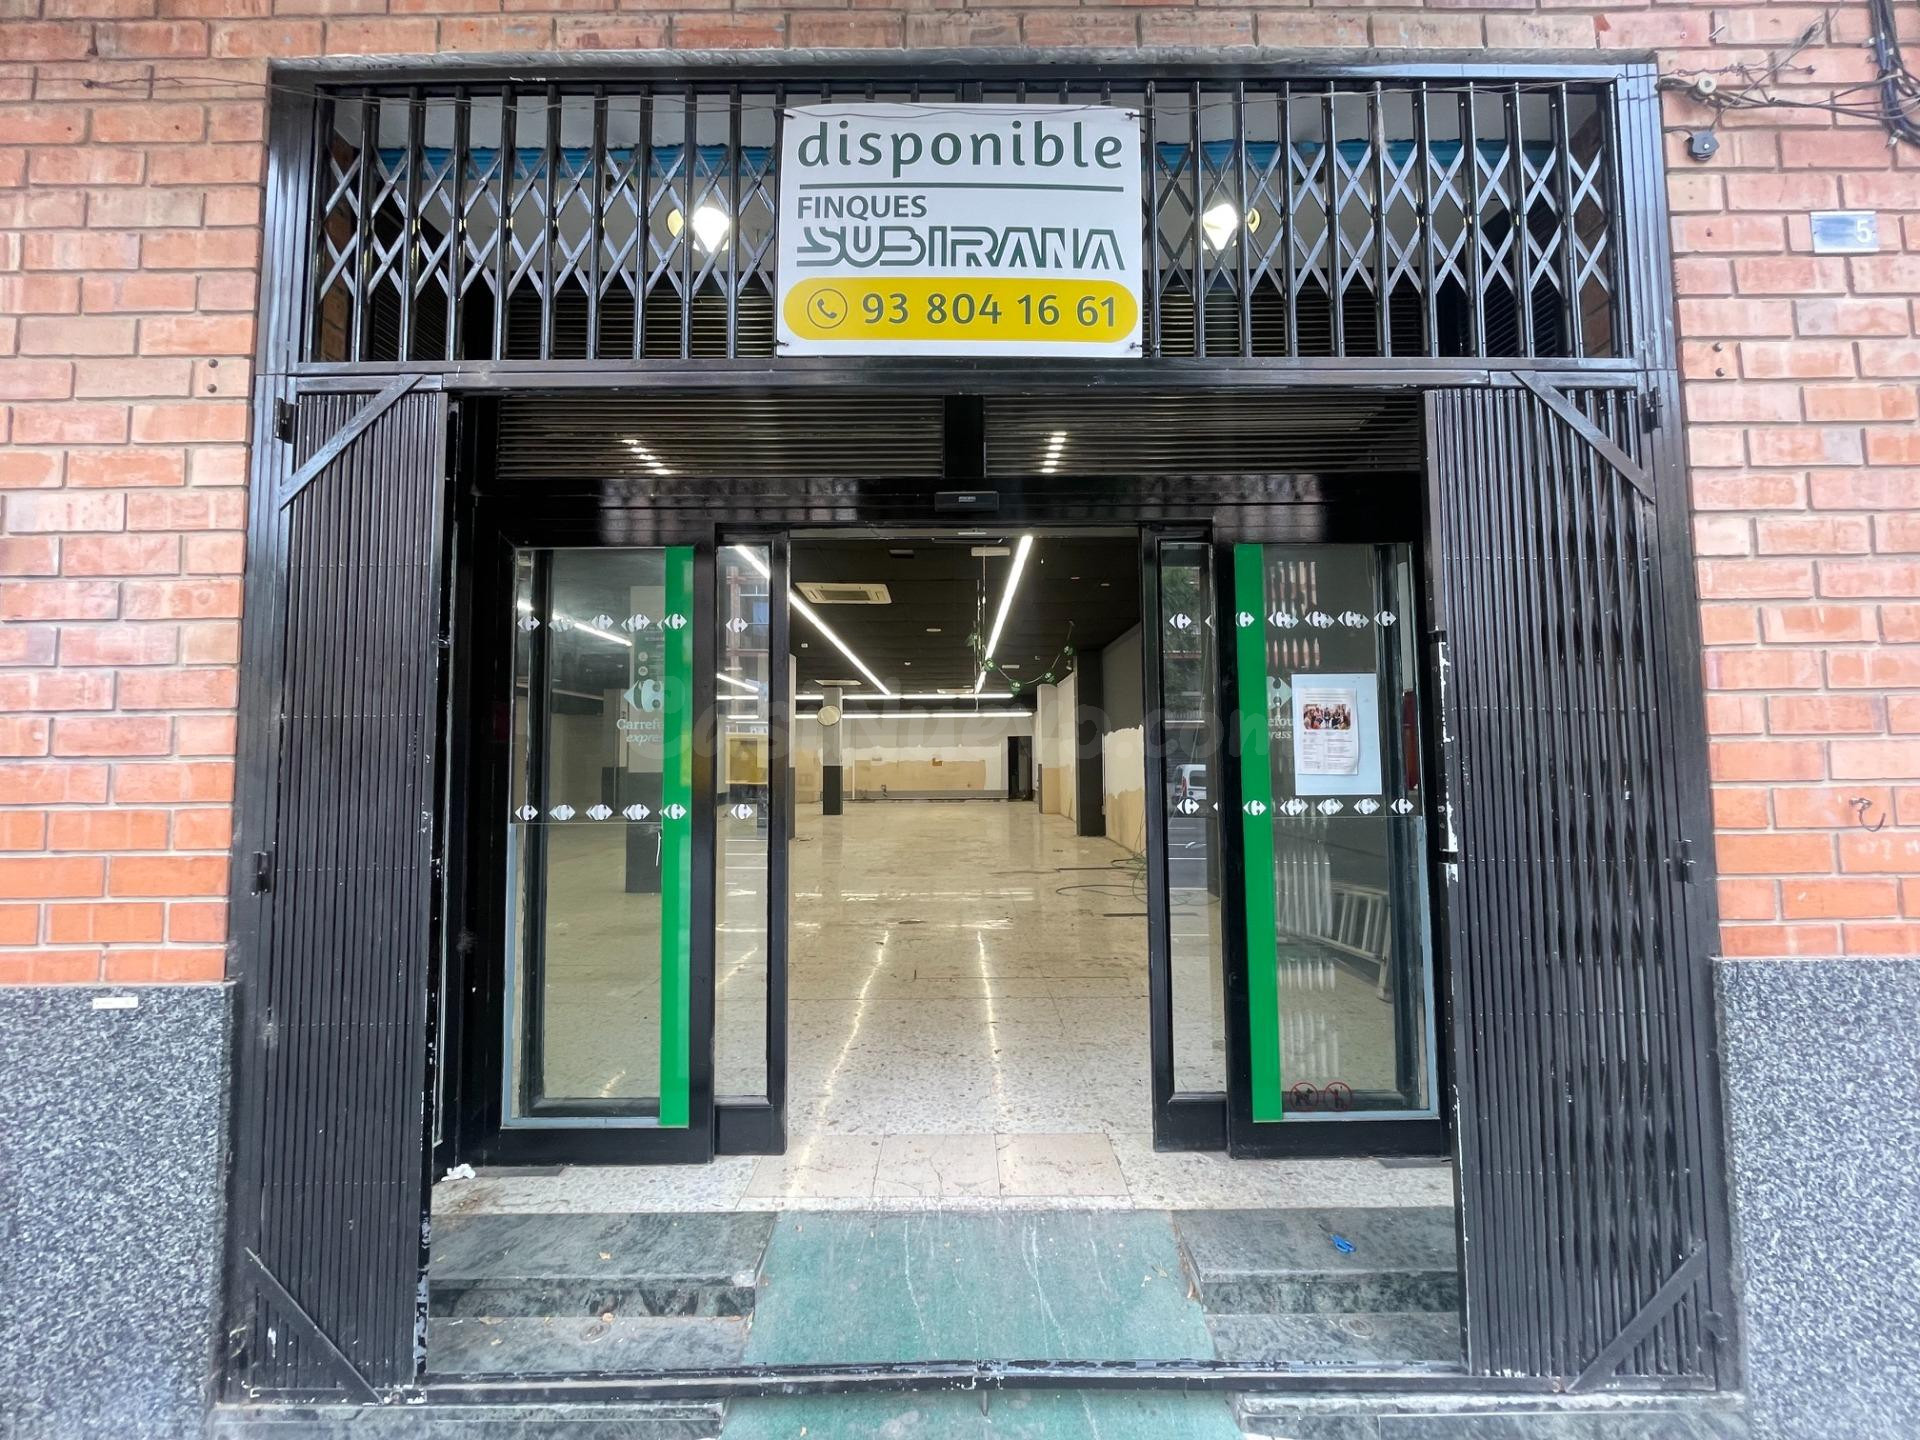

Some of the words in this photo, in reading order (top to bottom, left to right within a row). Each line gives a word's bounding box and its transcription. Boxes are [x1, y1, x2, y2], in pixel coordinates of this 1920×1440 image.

[797, 120, 1122, 178] disponible
[797, 195, 928, 221] FINQUES
[796, 225, 1126, 271] SUBIRANA
[1857, 220, 1872, 244] 5
[862, 292, 909, 325] 93
[926, 292, 1003, 326] 804
[1017, 294, 1060, 326] 16
[1076, 294, 1116, 327] 61
